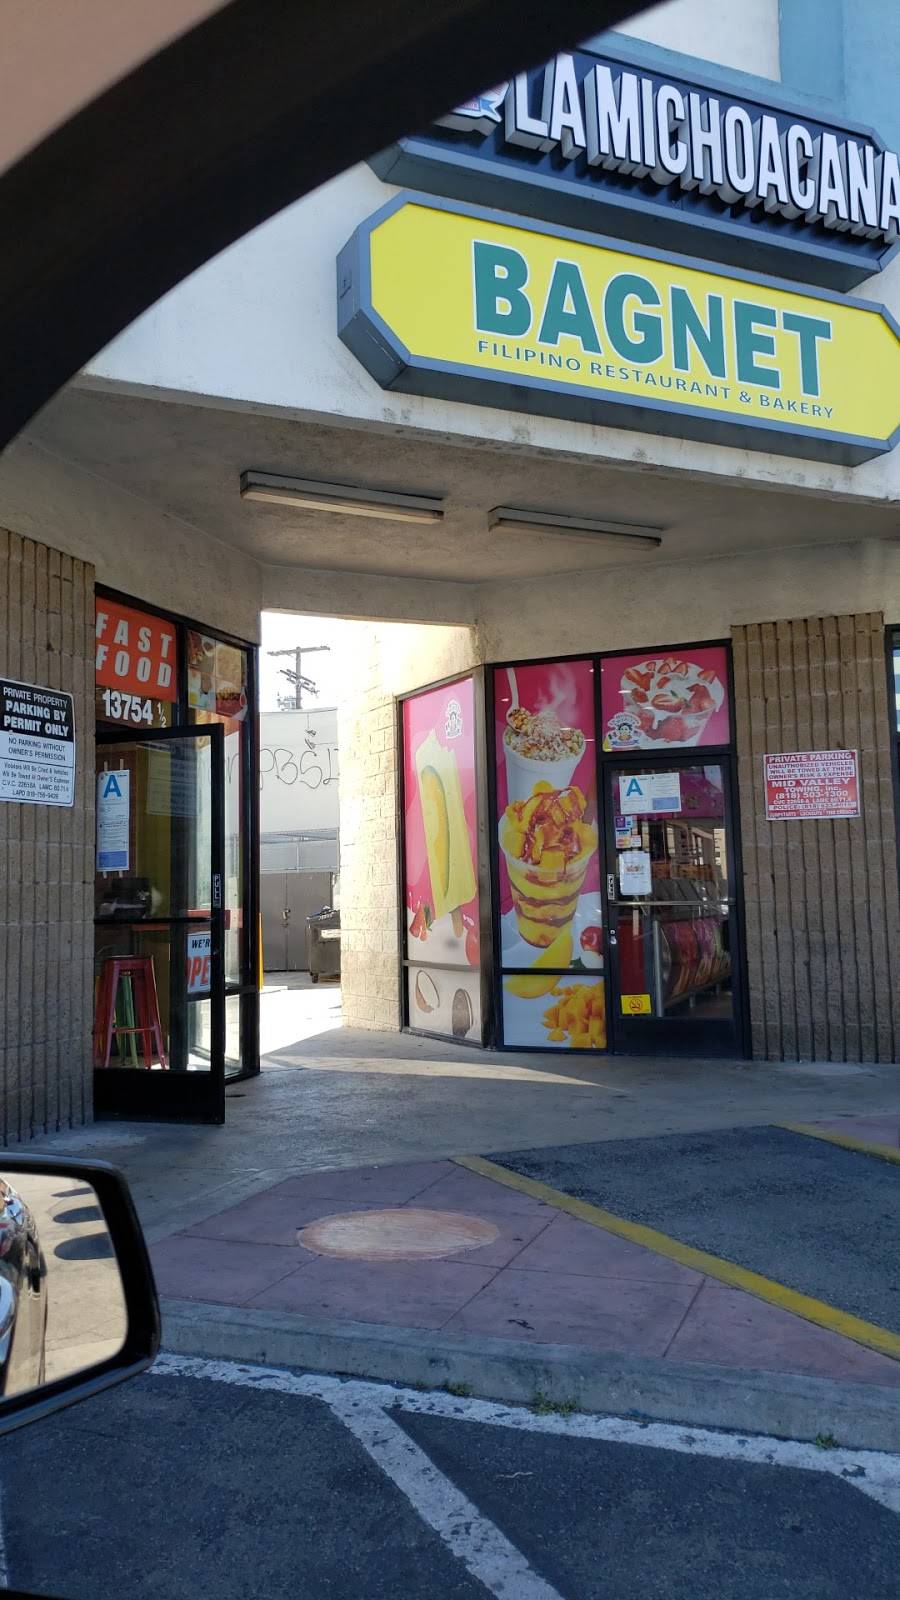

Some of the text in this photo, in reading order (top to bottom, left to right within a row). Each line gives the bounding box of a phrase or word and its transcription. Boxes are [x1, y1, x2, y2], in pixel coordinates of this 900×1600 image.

[513, 53, 900, 234] LA MICHOACANA
[471, 238, 832, 398] BAGNET
[478, 340, 833, 419] FILIPINO RESTAURANT & BAKERY
[95, 611, 173, 659] FAST
[95, 643, 172, 688] FOOD
[3, 686, 68, 708] PRIVATE PROPERTY
[102, 688, 154, 725] 13754
[5, 700, 67, 722] PARKING BY
[3, 715, 69, 737] PERMIT ONLY
[8, 737, 66, 753] NO PARKING WITHOUT
[8, 747, 66, 762] OWNER'S PERMISSION
[768, 752, 852, 763] PRIVATE PARKING
[103, 774, 122, 799] A
[625, 777, 644, 797] A
[771, 777, 851, 788] MID VALLEY
[775, 790, 849, 800] (818) 503-1300
